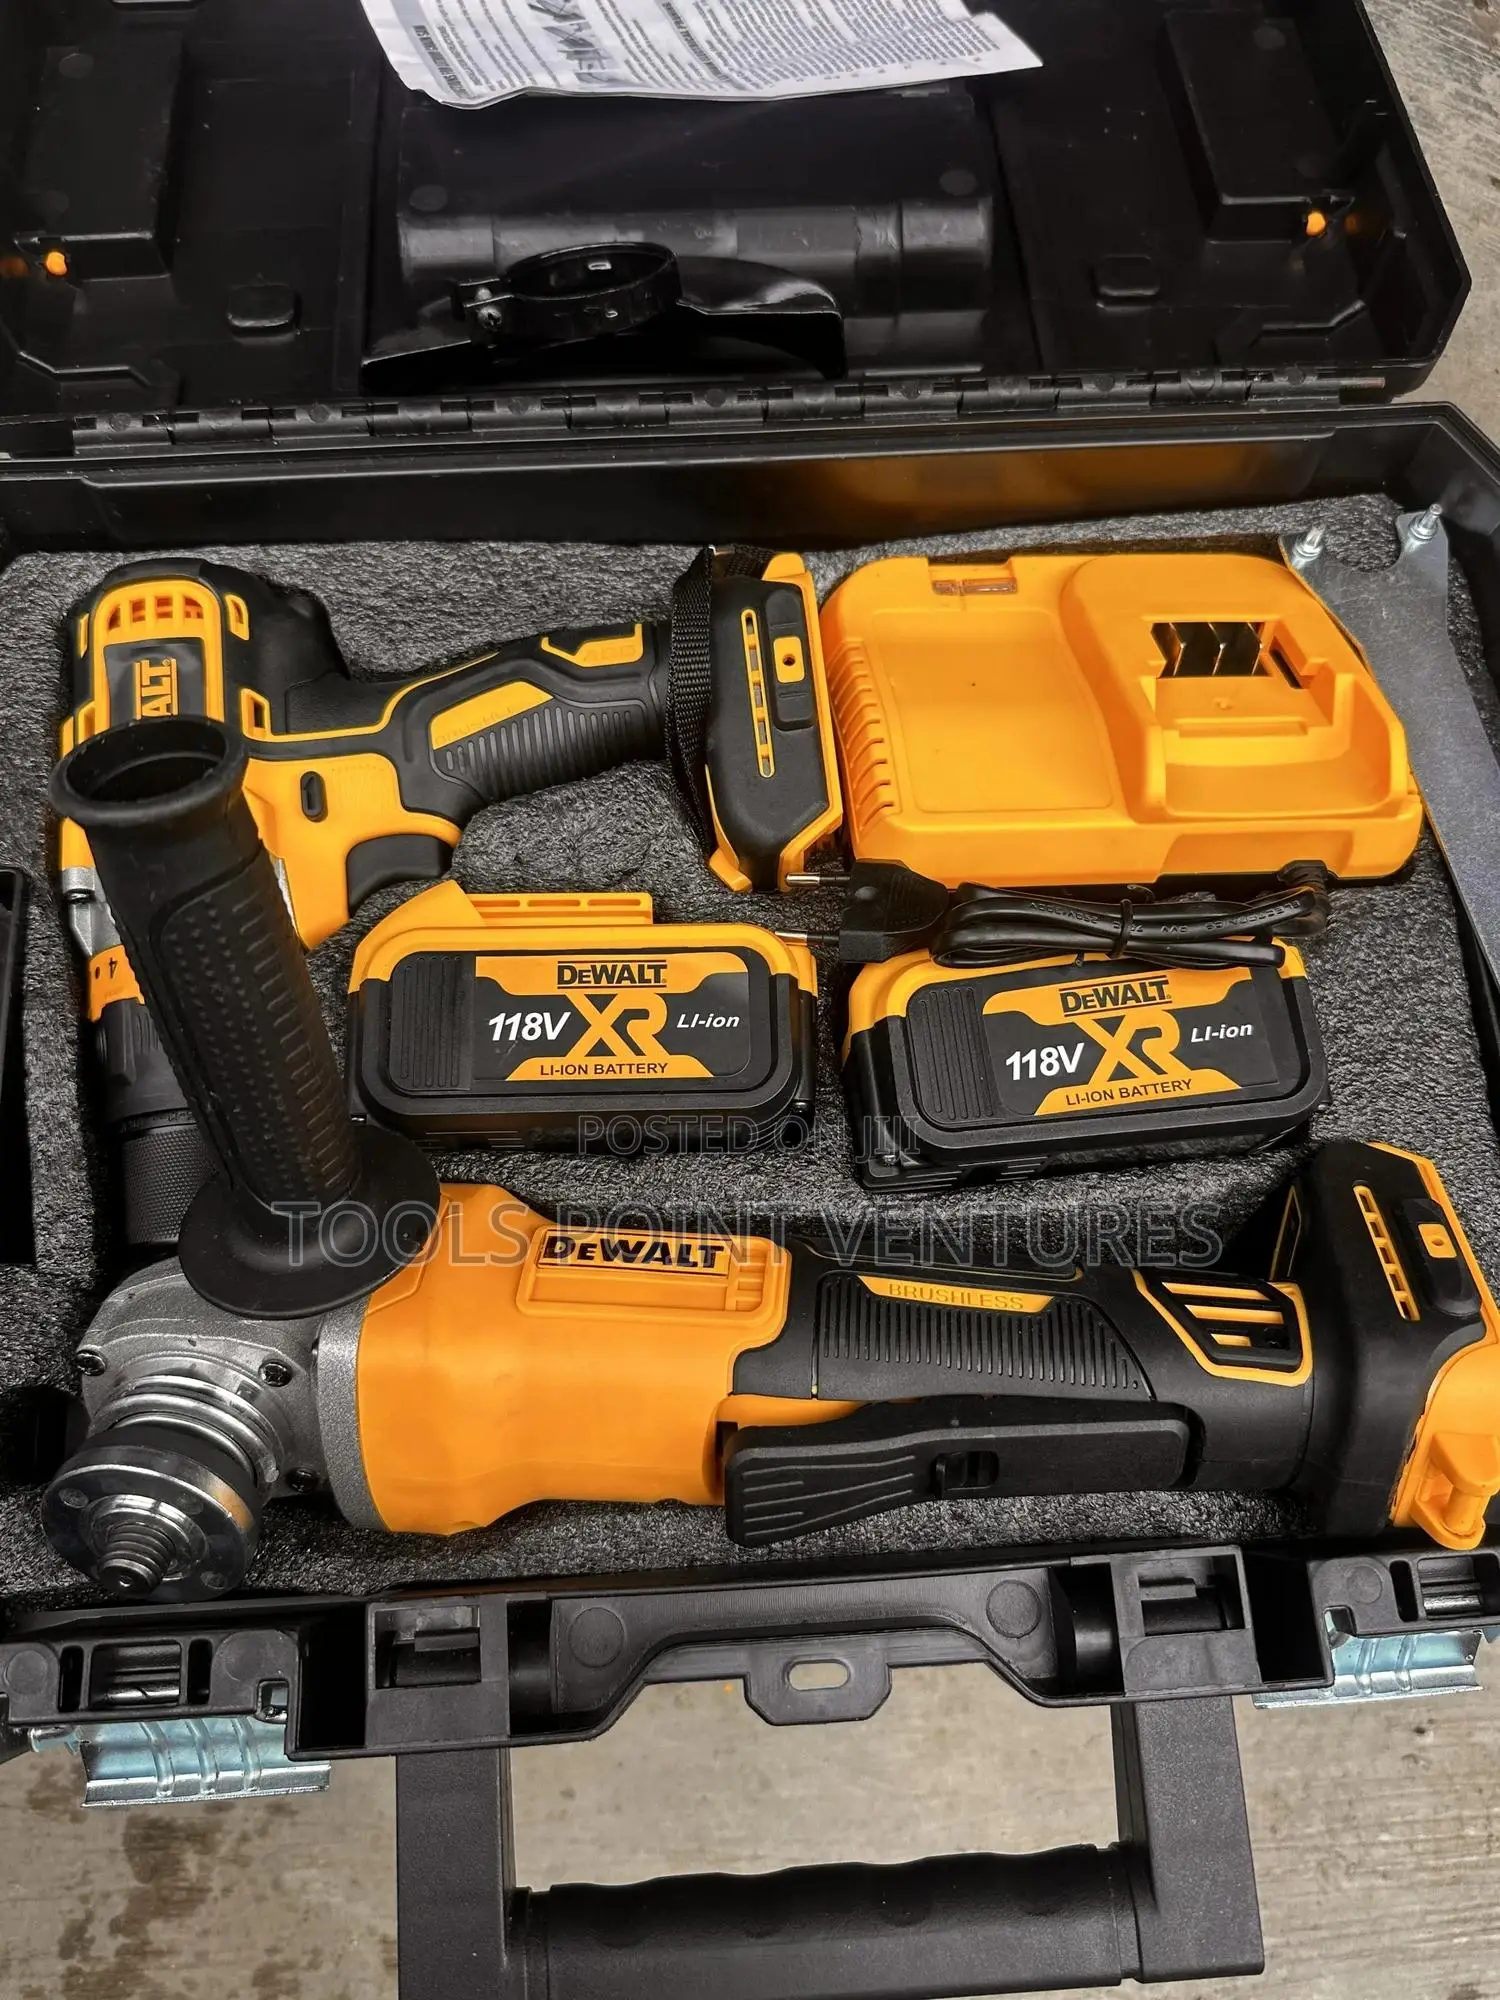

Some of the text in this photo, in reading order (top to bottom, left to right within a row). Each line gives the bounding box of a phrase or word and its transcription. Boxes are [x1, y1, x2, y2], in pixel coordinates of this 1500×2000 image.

[140, 658, 173, 718] ALT
[487, 1011, 572, 1042] 118V
[562, 992, 674, 1058] XR
[540, 1062, 669, 1076] LI-ION BATTERY
[1005, 1042, 1085, 1081] 118V
[1074, 1010, 1194, 1085] XR
[1066, 1078, 1193, 1106] LI-ION BATTERY
[888, 1283, 1025, 1309] BRUSHLESS
